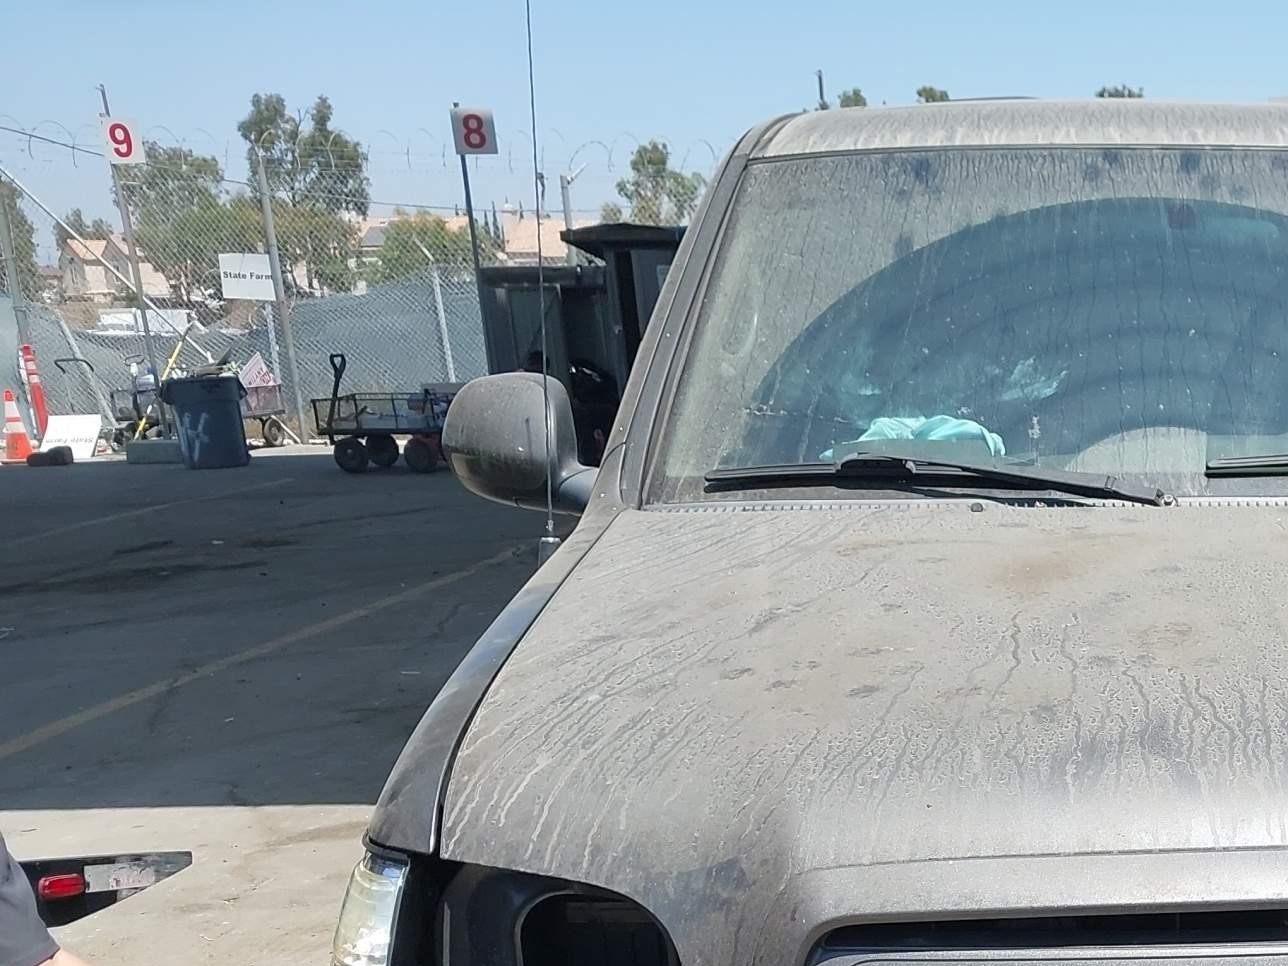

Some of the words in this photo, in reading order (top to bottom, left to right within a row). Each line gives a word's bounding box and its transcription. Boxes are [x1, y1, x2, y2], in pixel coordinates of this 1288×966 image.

[109, 123, 133, 158] 9
[462, 113, 487, 149] 8
[222, 271, 247, 280] State
[249, 271, 273, 280] Farm
